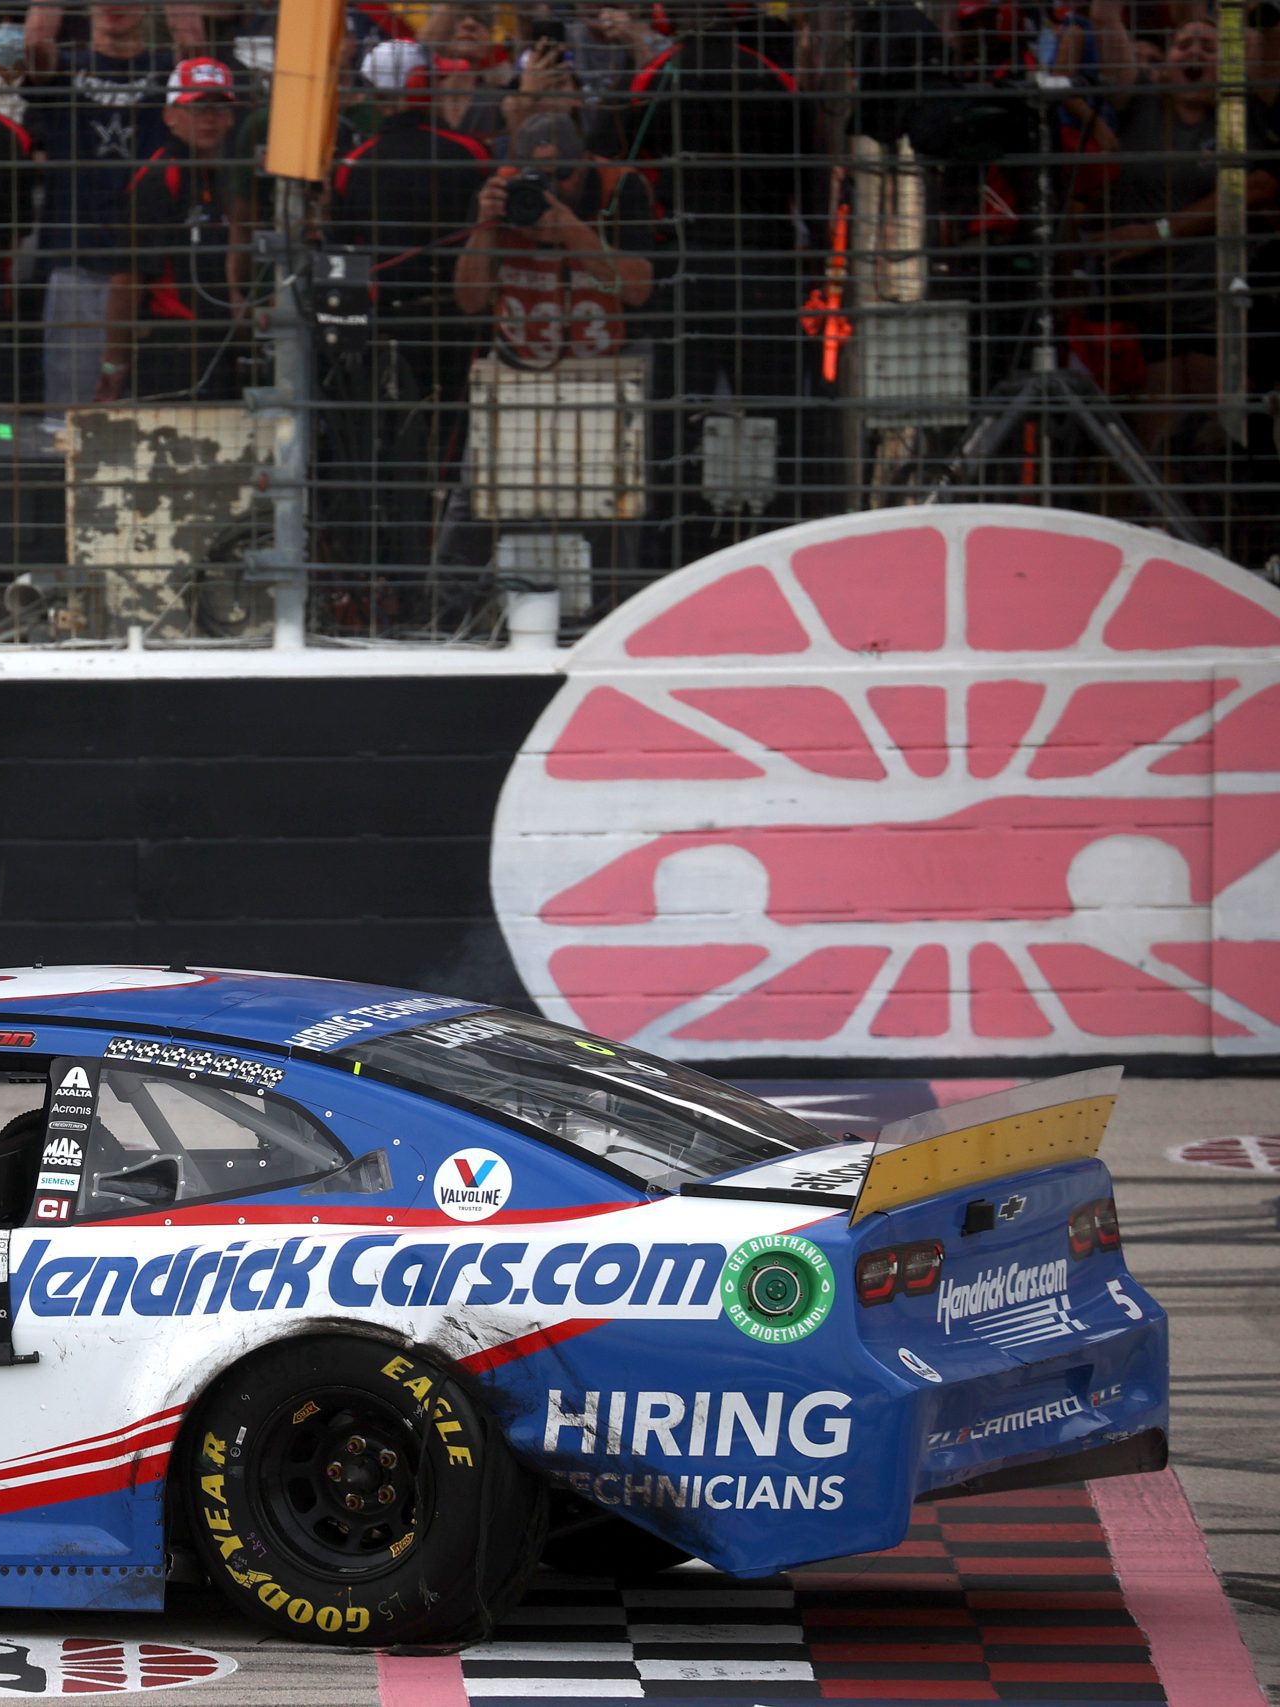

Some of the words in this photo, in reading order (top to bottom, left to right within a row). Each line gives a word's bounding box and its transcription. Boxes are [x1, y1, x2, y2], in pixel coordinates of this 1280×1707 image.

[285, 1015, 373, 1051] HIRING
[413, 1017, 518, 1049] LARSON
[51, 1103, 92, 1115] Acronis
[55, 1088, 92, 1098] AXALTA
[42, 1157, 82, 1167] TOOLS
[43, 1137, 83, 1158] MAC
[41, 1177, 75, 1186] SIEMENS
[441, 1187, 501, 1206] VALVOLINE
[728, 1247, 750, 1272] GET
[749, 1236, 827, 1275] BIOETHANOL
[1106, 1279, 1143, 1320] 5
[729, 1304, 751, 1326] GET
[749, 1304, 826, 1341] BIOETHANOL
[380, 1355, 473, 1468] EAGLE
[544, 1389, 853, 1458] HIRING
[970, 1395, 1084, 1440] CAMARO
